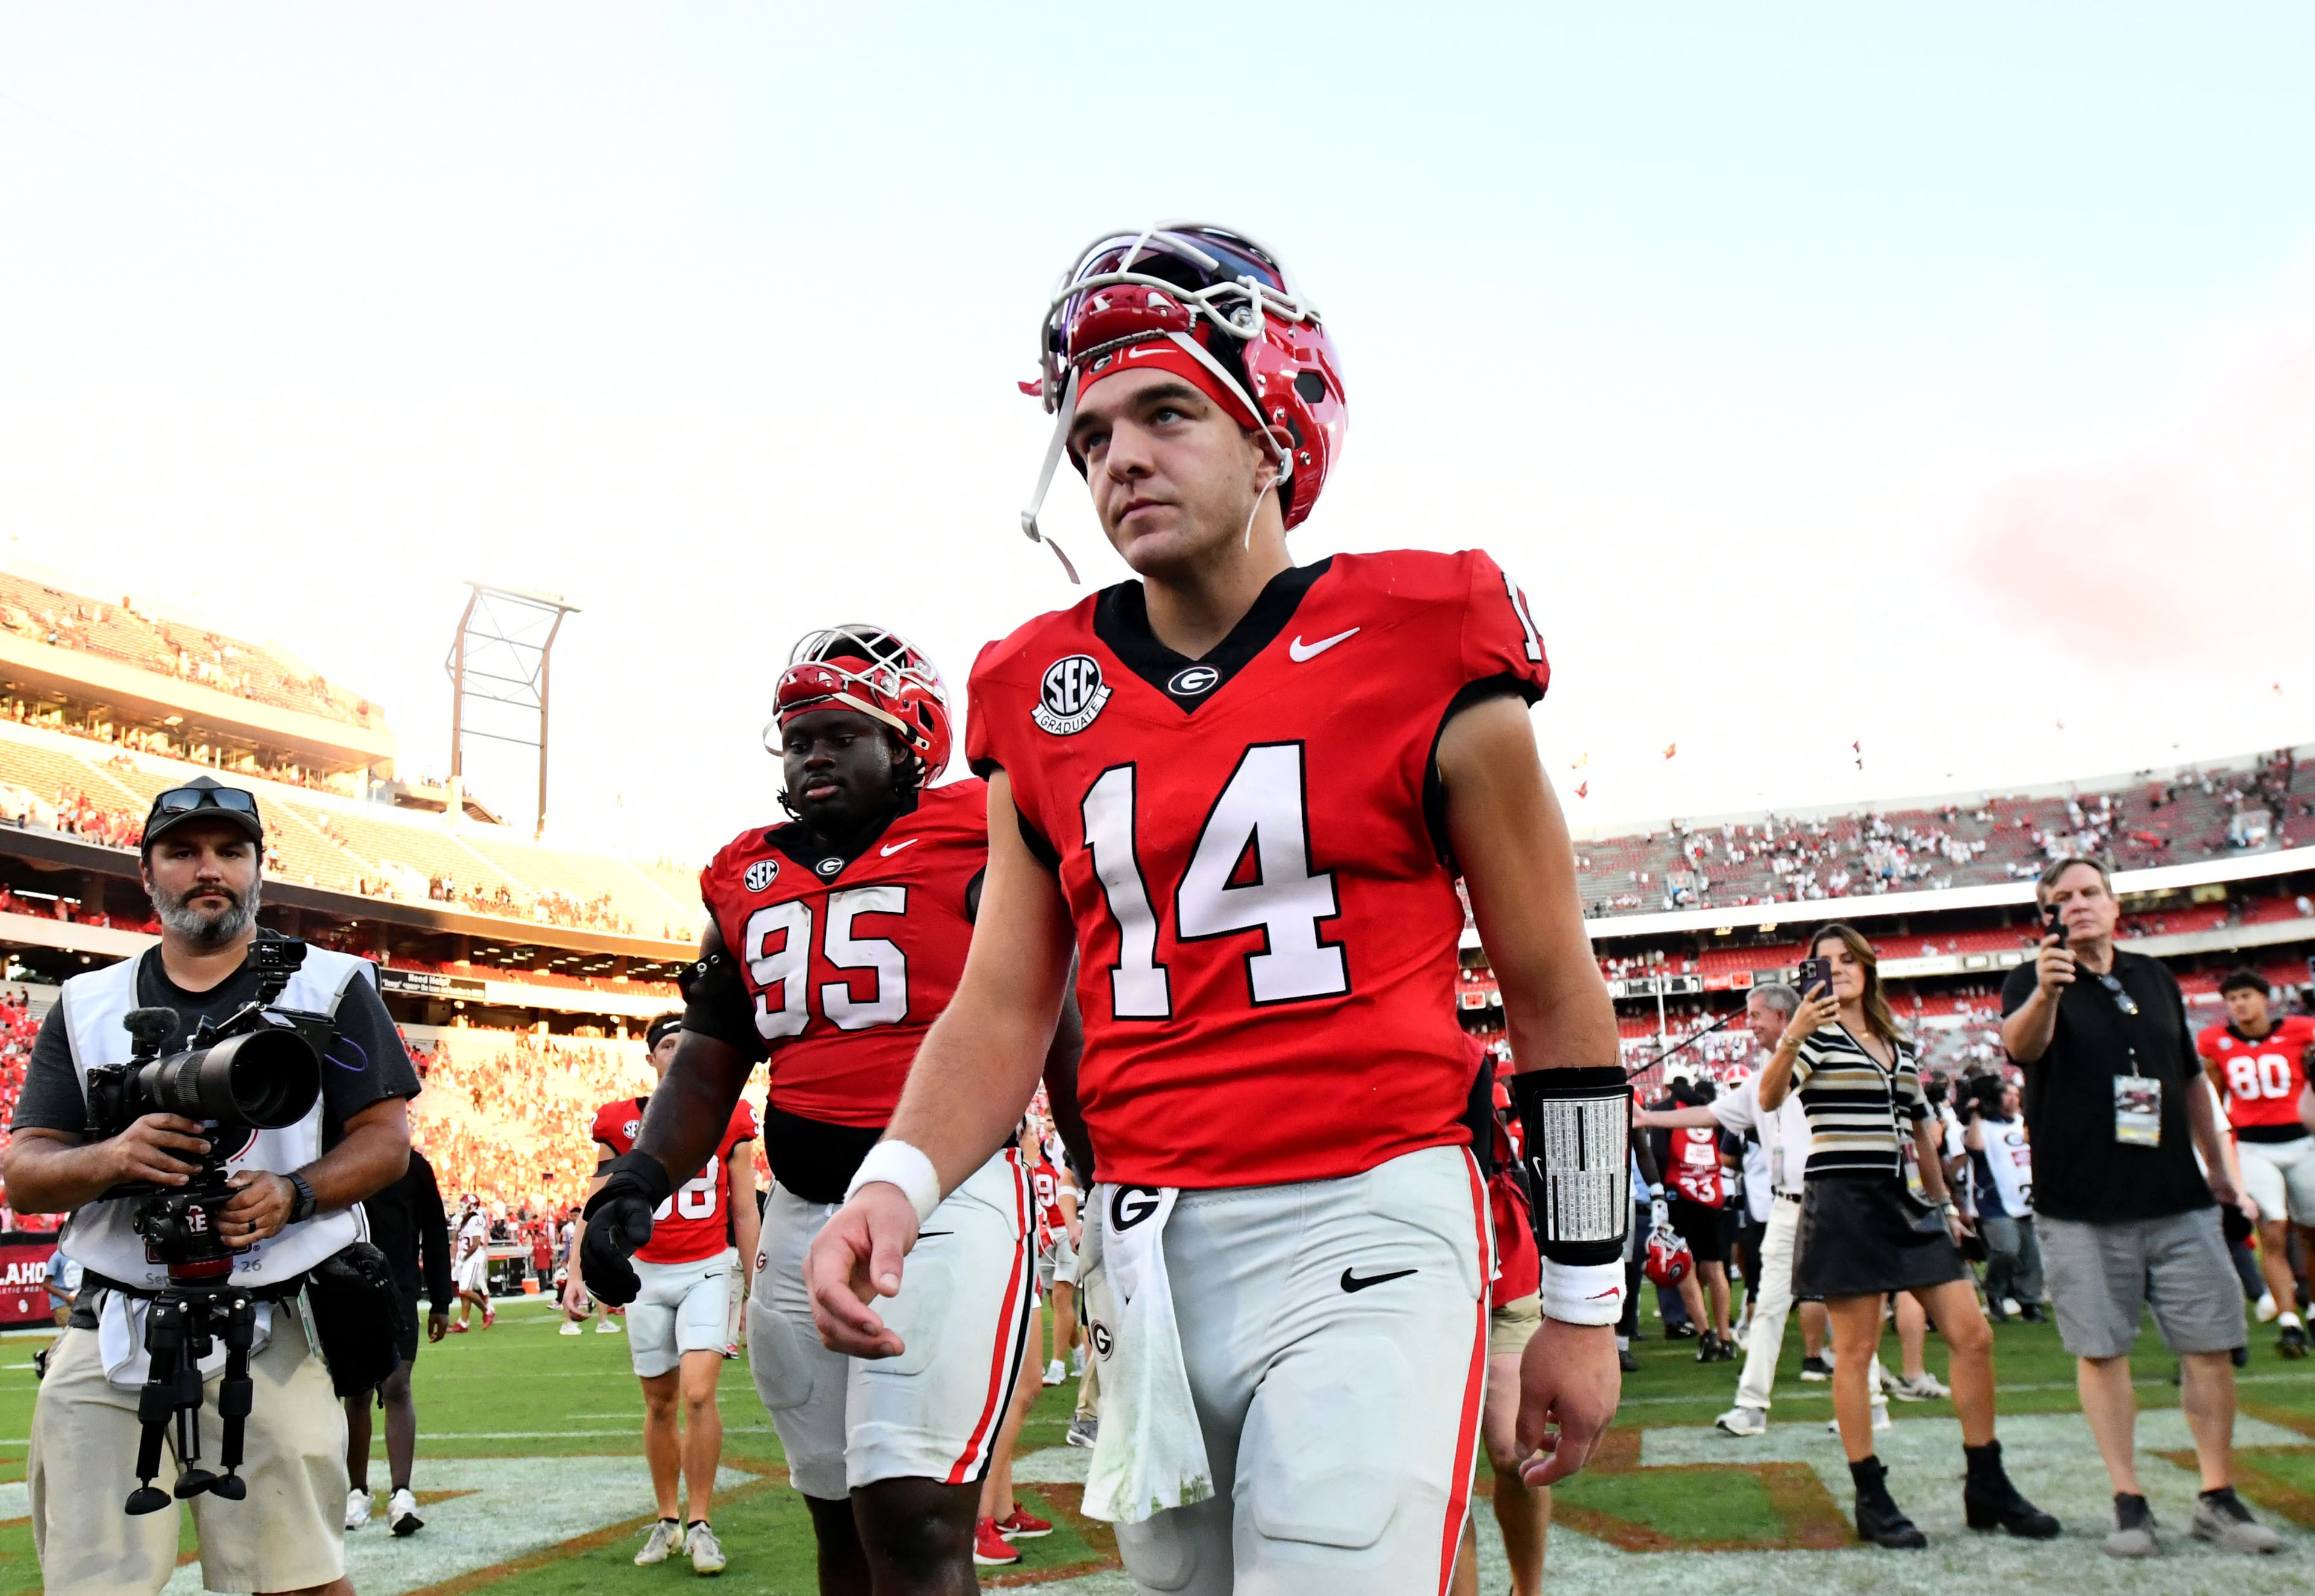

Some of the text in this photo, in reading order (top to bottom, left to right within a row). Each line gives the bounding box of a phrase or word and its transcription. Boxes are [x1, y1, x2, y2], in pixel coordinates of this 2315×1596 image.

[1045, 658, 1096, 715] SEC
[1168, 667, 1218, 695] G
[1040, 701, 1101, 734] GRADUATE
[745, 861, 776, 890] SEC
[816, 858, 844, 875] G
[1079, 739, 1353, 1022] 14
[408, 973, 428, 984] Need
[745, 885, 909, 1040] 95
[2226, 1054, 2291, 1101] 80
[1110, 1183, 1162, 1233] G
[241, 1259, 262, 1272] 26
[1092, 1320, 1113, 1362] G
